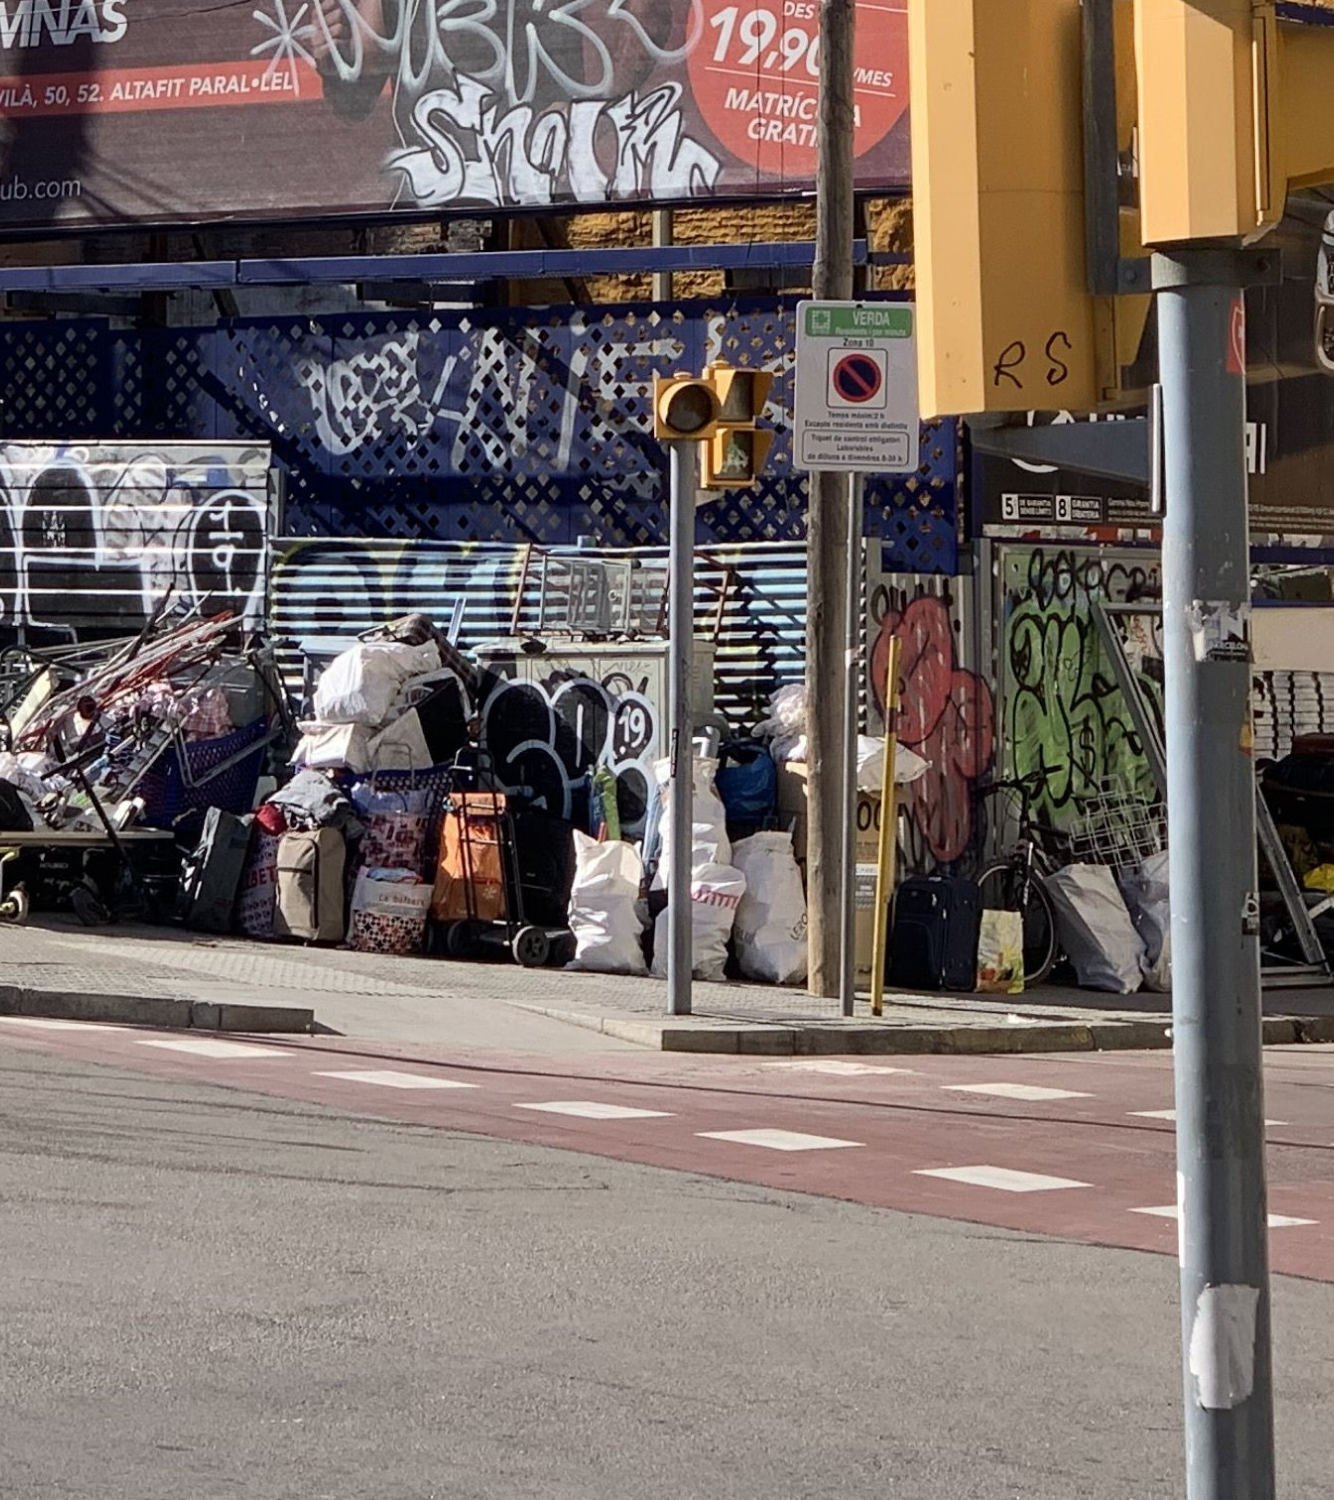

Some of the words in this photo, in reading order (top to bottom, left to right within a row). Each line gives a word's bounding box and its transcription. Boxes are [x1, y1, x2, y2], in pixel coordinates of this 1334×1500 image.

[45, 85, 70, 107] 50,
[77, 83, 104, 103] 52.
[110, 77, 186, 101] ALTAFIT
[724, 85, 861, 128] MATRÍCA
[747, 117, 820, 149] GRATI
[852, 311, 890, 326] VERDA
[994, 341, 1026, 389] R
[1045, 331, 1072, 385] S
[1005, 497, 1015, 516] 5
[1058, 498, 1067, 517] 8
